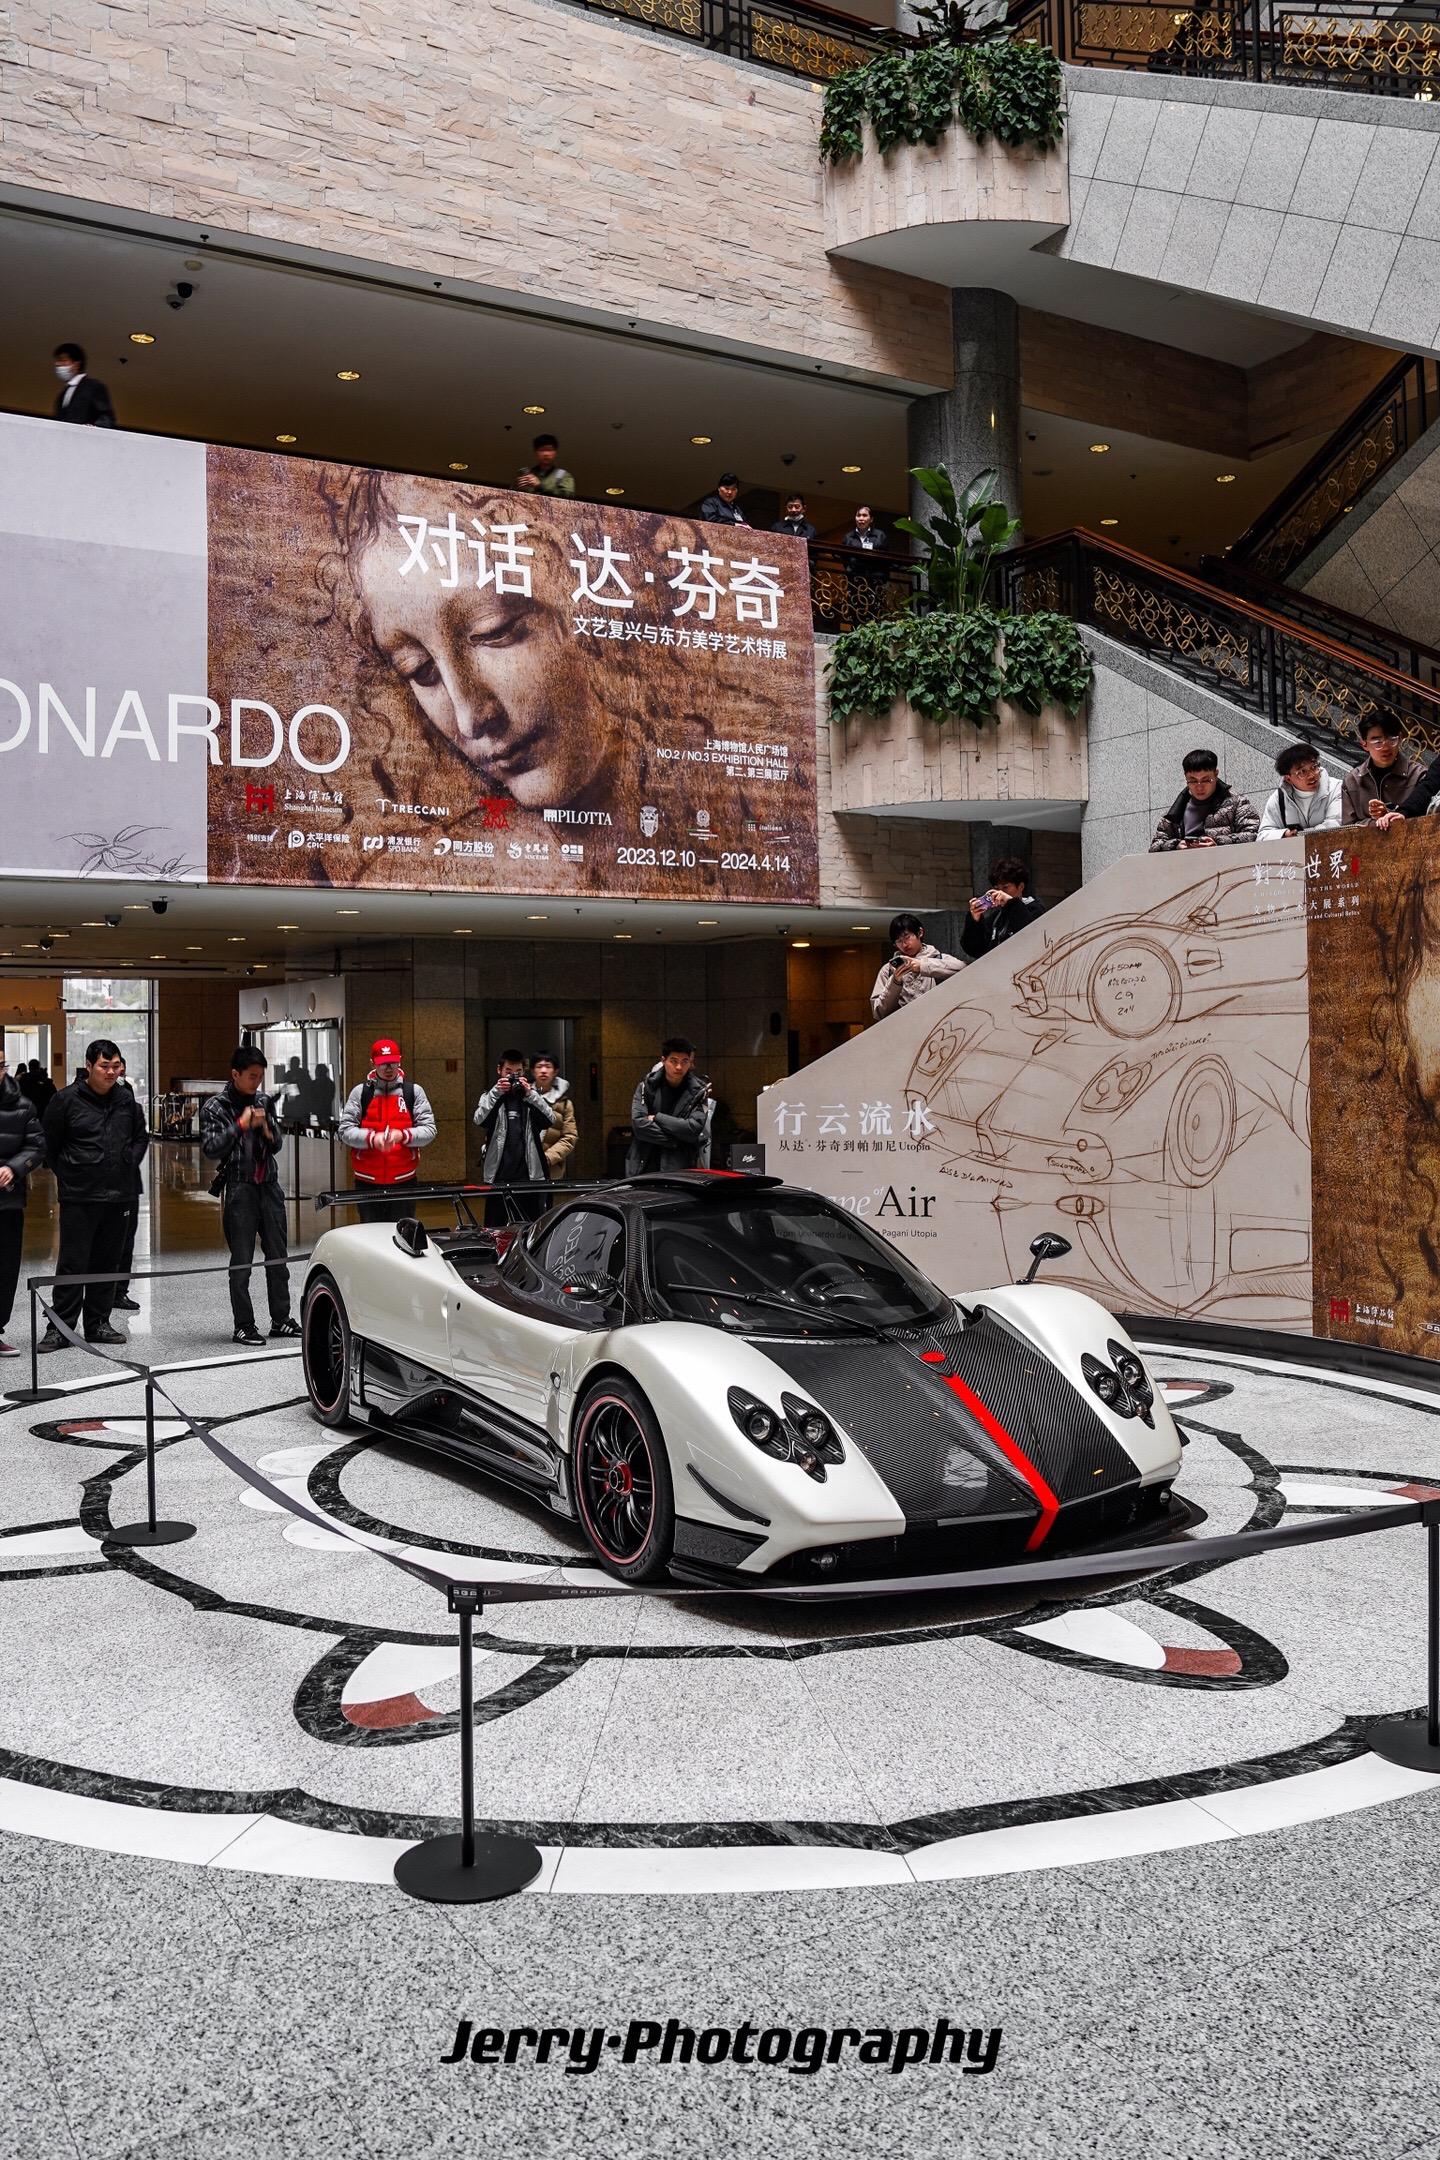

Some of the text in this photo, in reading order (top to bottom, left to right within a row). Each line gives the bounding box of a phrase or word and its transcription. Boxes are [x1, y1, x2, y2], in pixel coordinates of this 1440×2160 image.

[396, 511, 785, 630] 对话 达·芬奇
[572, 614, 788, 661] 文艺复兴与东方美学艺术特展
[656, 747, 680, 760] NO.2
[687, 751, 710, 763] NO.3
[711, 752, 765, 767] EXHIBITION
[765, 756, 789, 769] HALL
[703, 738, 789, 758] 上海博物馆人民广场馆
[725, 765, 789, 782] 第二、第三展览厅
[391, 803, 450, 817] TRECCANI
[557, 809, 613, 827] PILOTTA
[617, 846, 696, 868] 2023.12.10
[720, 852, 791, 872] 2024.4.14
[774, 1100, 937, 1137] 行云流水
[874, 1185, 936, 1218] Air
[881, 1228, 909, 1240] Pagani
[910, 1228, 938, 1239] Utopia
